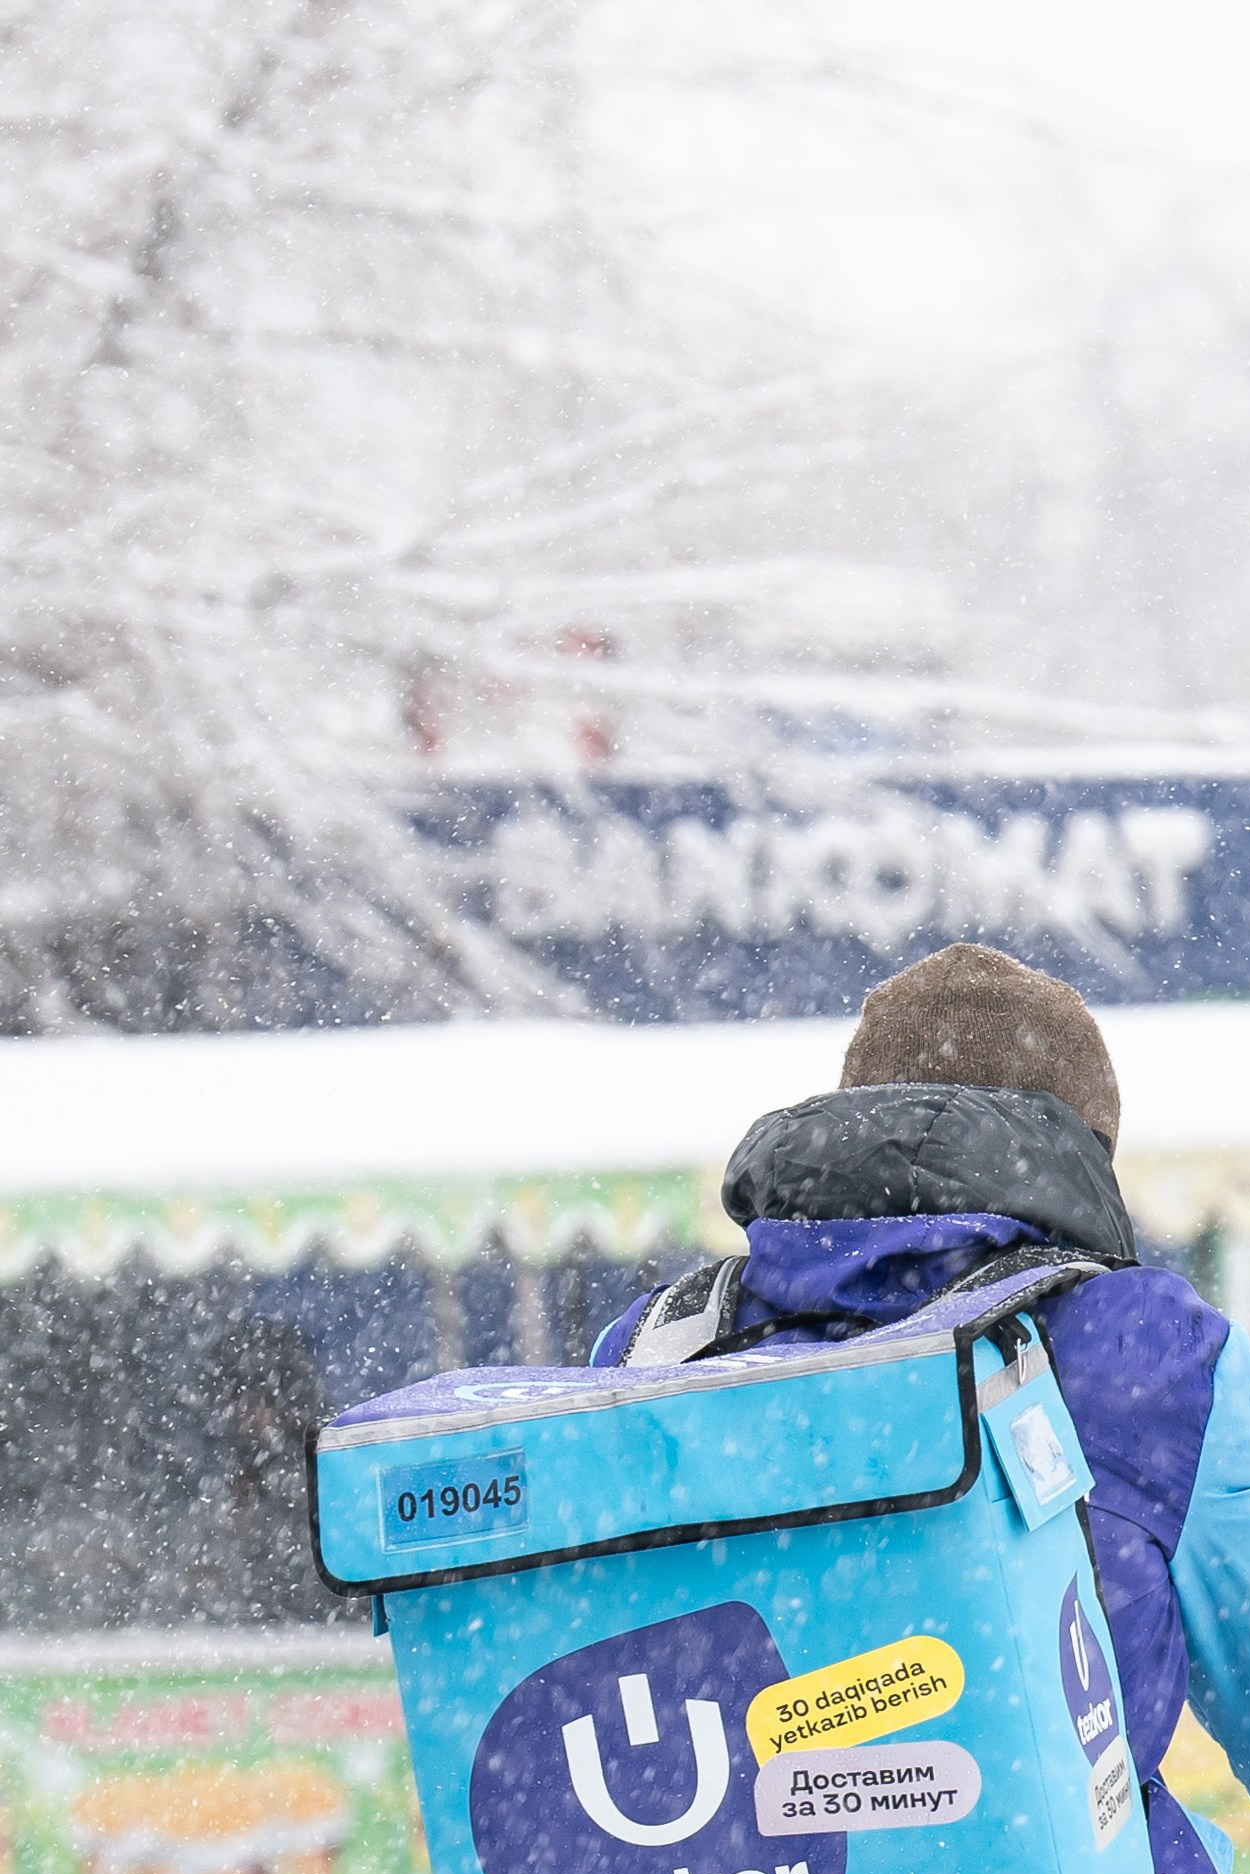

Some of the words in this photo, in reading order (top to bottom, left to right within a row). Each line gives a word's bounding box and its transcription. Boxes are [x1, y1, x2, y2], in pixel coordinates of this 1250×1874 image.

[397, 1475, 522, 1522] 019045
[769, 1704, 868, 1754] yetkazib
[871, 1675, 948, 1714] berish
[776, 1699, 809, 1723] 30
[815, 1662, 926, 1710] daqiqada
[1077, 1698, 1114, 1746] tezkor
[781, 1801, 816, 1818] за
[823, 1792, 862, 1814] 30
[871, 1789, 958, 1812] минут
[790, 1766, 935, 1796] Доставим
